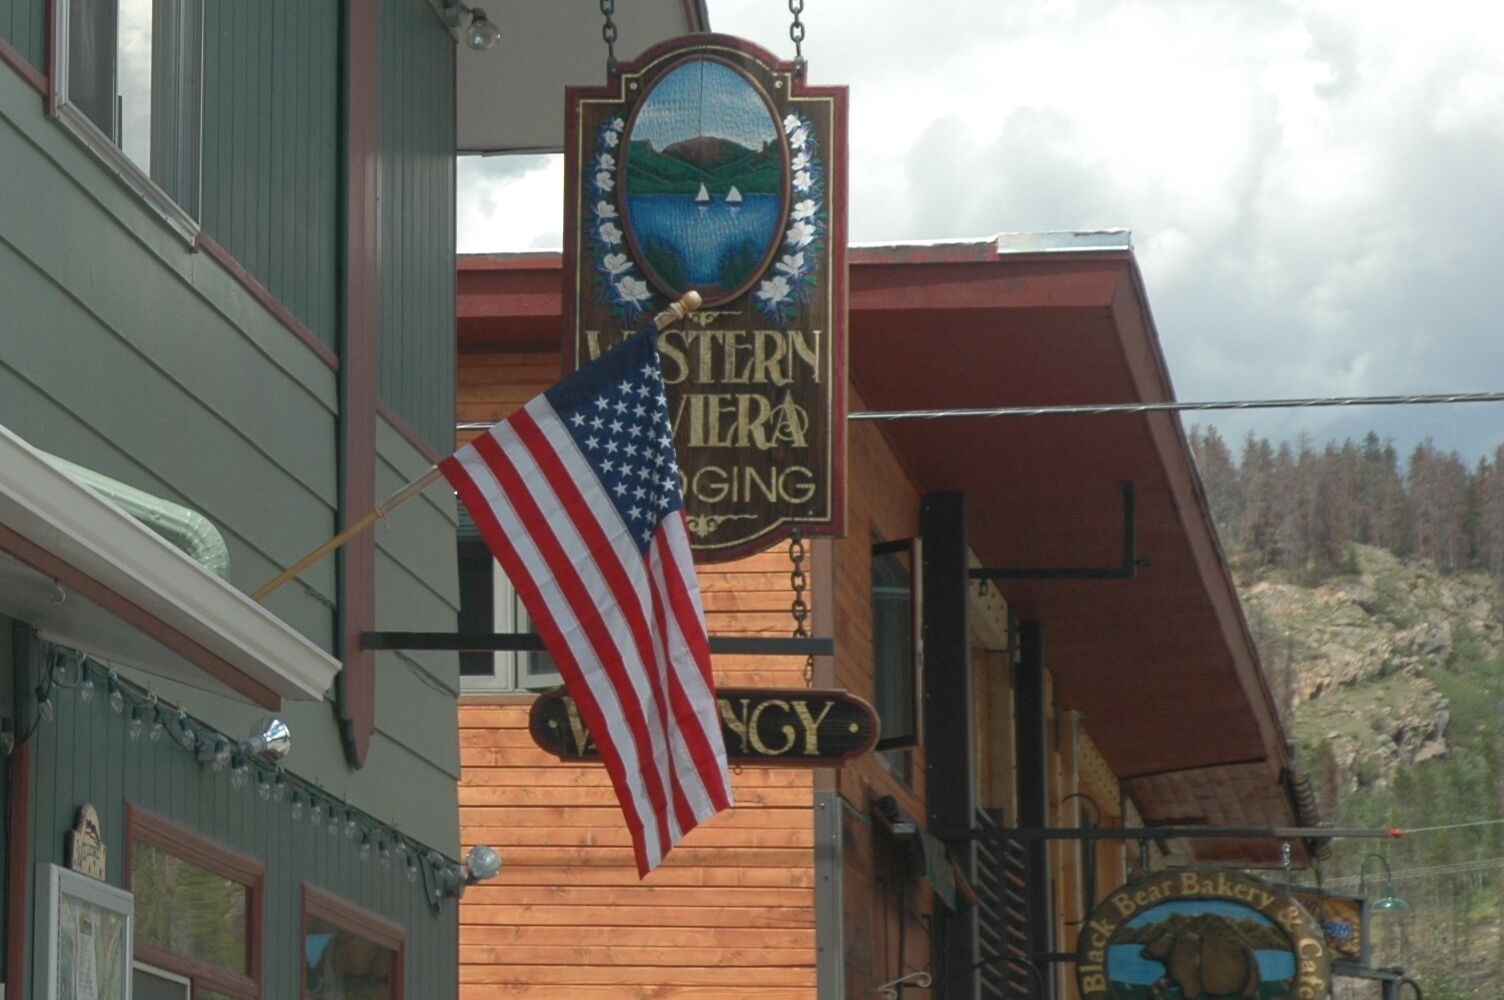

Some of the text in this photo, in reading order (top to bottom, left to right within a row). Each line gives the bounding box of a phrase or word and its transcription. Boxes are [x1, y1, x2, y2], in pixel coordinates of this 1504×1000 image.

[586, 329, 823, 387] STERN
[672, 389, 809, 450] IERA
[678, 465, 816, 504] GING
[563, 697, 836, 757] VNCY
[1080, 918, 1117, 994] Black
[1111, 879, 1173, 918] Bear
[1179, 871, 1276, 910] Bakery
[1277, 905, 1302, 933] &
[1298, 937, 1325, 999] Cafe
